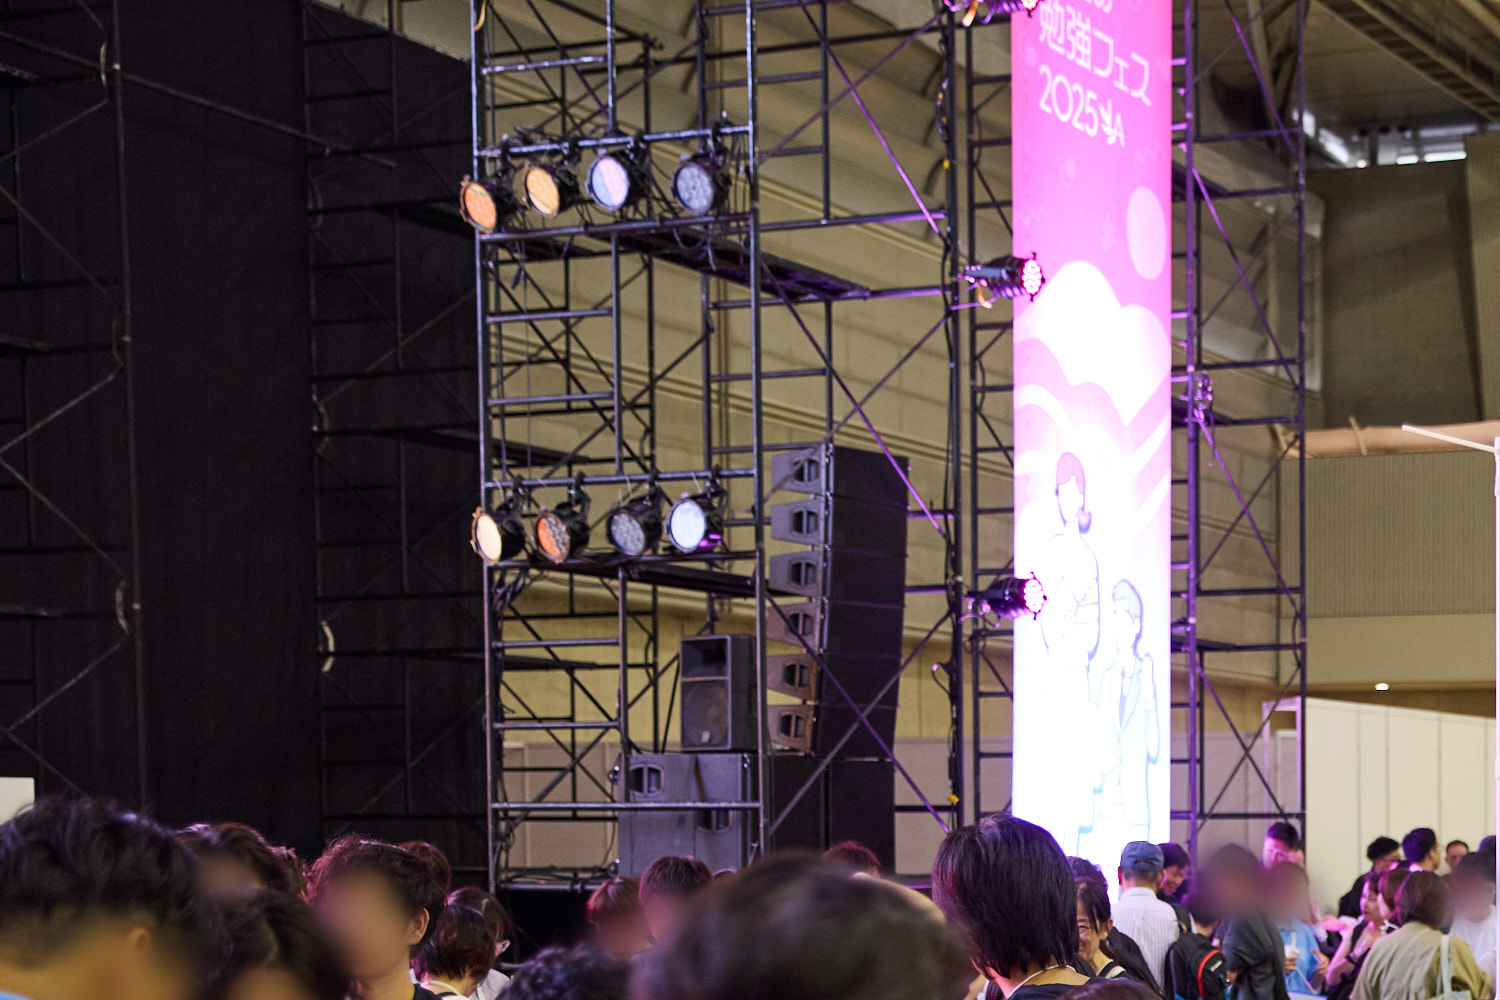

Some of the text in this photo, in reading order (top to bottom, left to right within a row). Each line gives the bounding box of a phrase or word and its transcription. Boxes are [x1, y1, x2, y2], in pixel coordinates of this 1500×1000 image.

[1038, 0, 1152, 107] 勉強フェス
[1038, 64, 1099, 137] 2025
